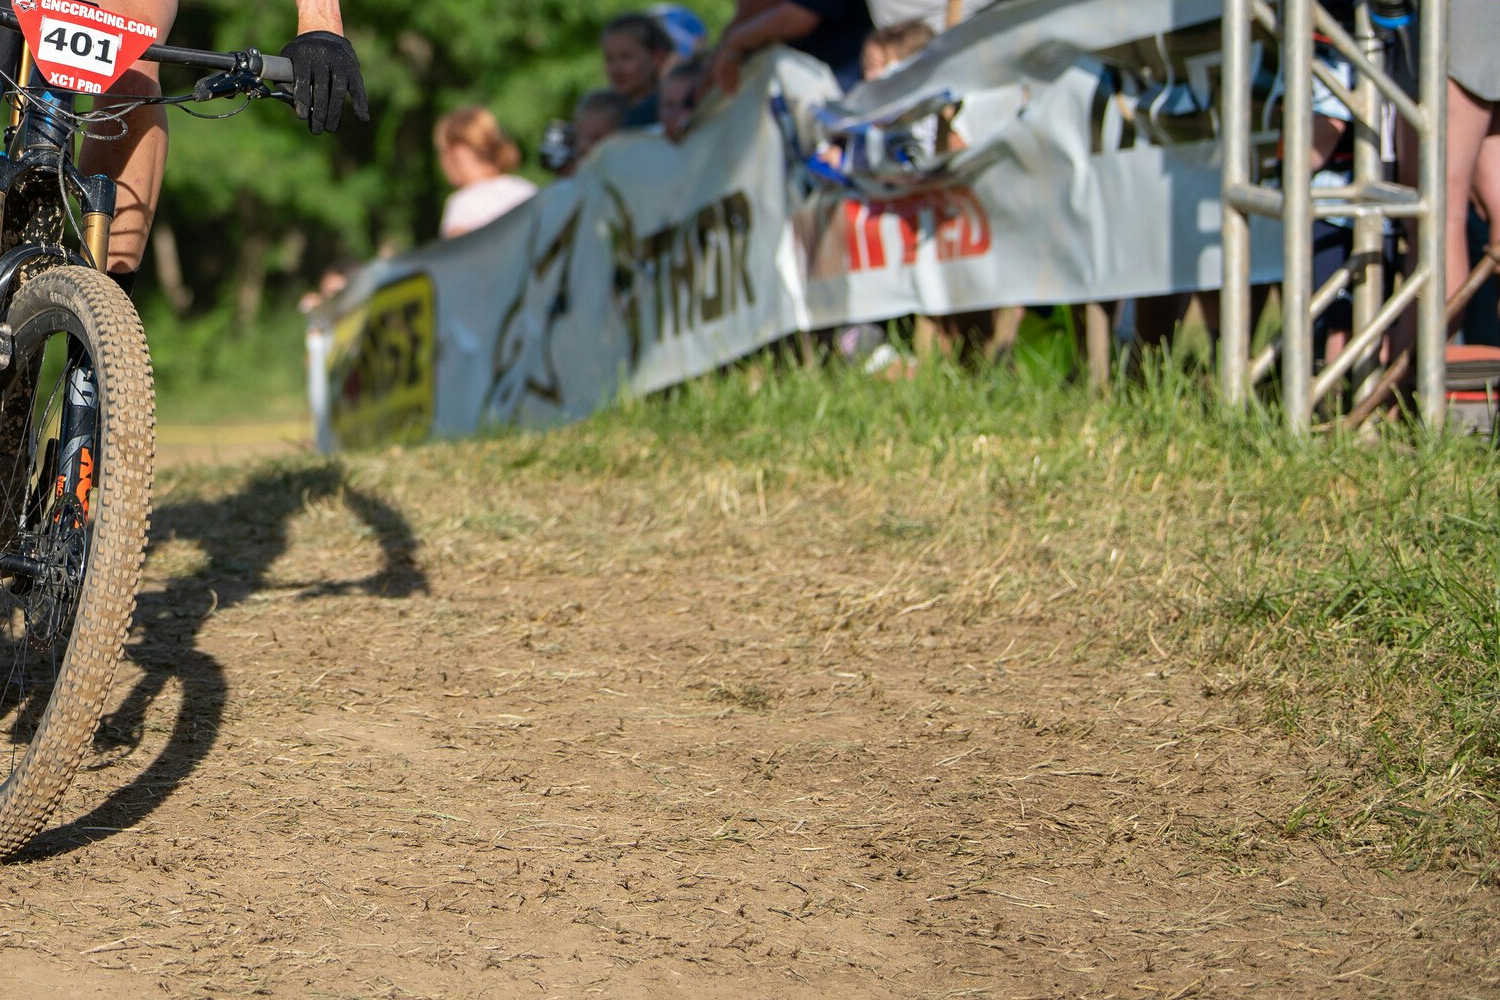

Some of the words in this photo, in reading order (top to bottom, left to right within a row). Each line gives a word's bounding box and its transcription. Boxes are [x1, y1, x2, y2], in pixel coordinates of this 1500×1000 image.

[43, 27, 113, 64] 401
[50, 71, 74, 88] XC1
[77, 79, 102, 94] PRO
